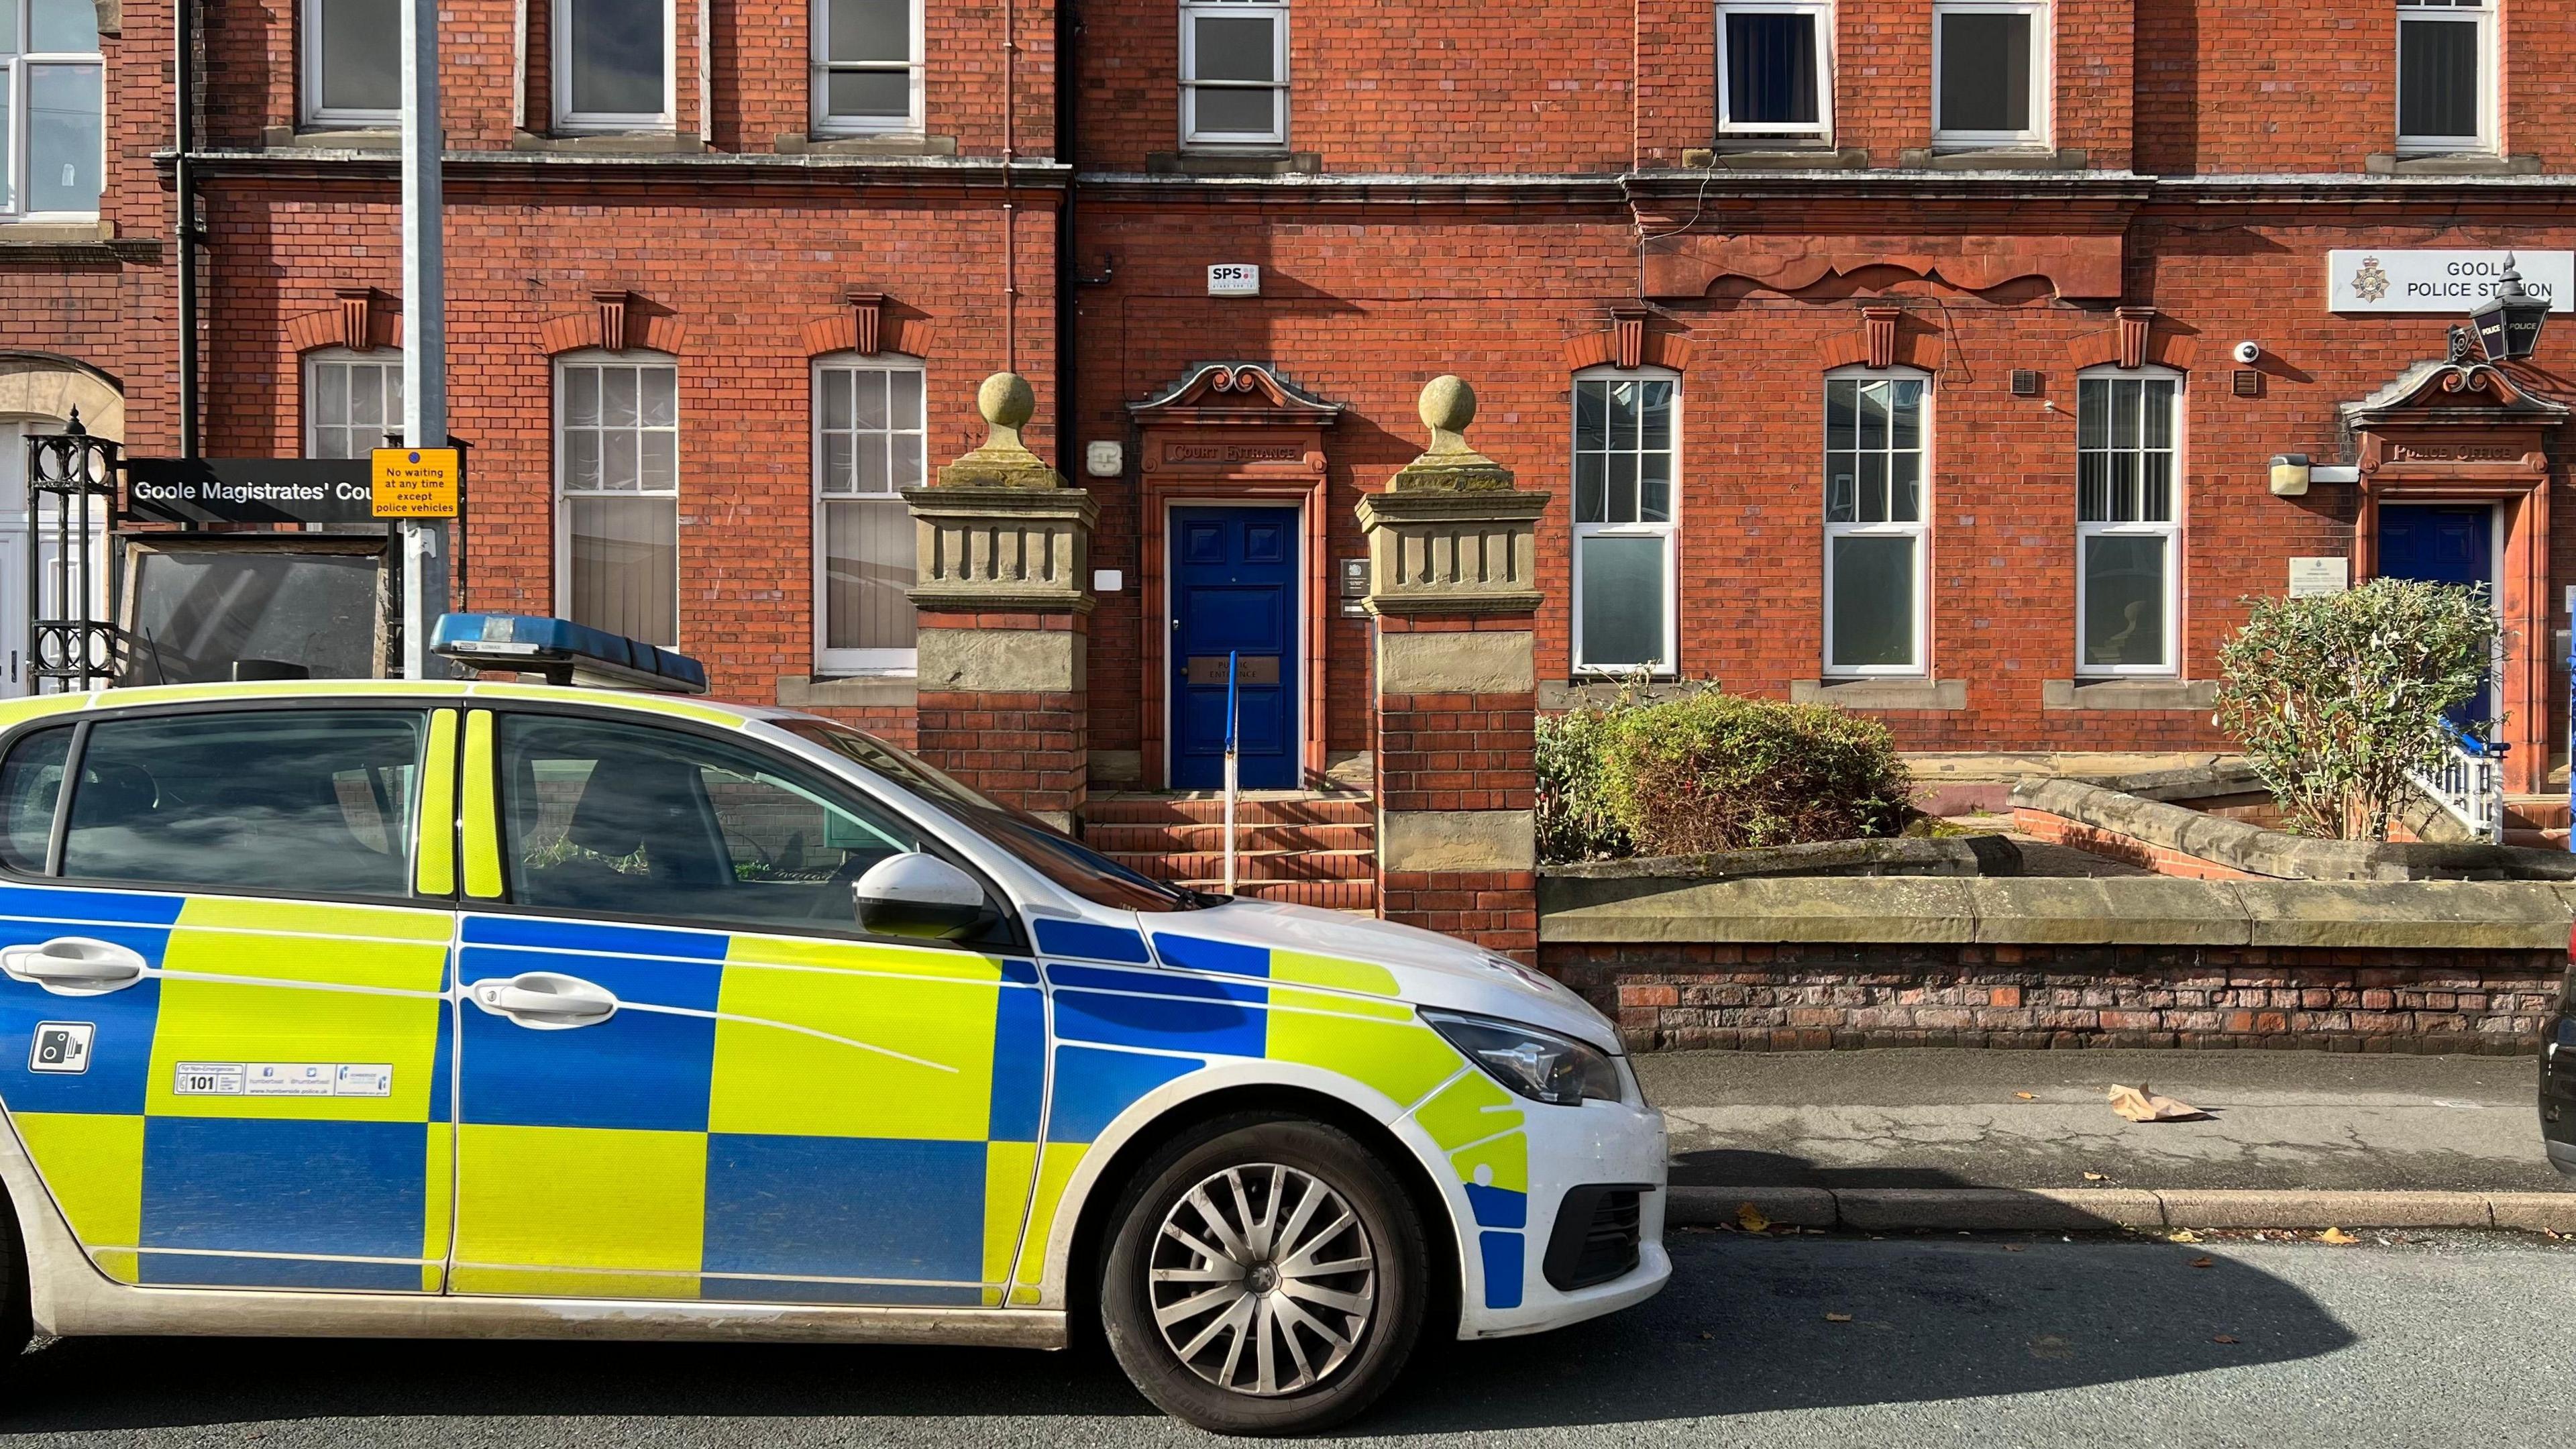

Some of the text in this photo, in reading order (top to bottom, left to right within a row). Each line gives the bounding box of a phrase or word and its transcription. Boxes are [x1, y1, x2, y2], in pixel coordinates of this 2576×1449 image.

[1213, 268, 1242, 280] SPS
[2408, 282, 2553, 297] POLICE STION
[2481, 325, 2501, 336] POLICE
[386, 468, 443, 478] No waiting
[385, 479, 444, 490] at any time
[135, 482, 196, 500] Goole
[202, 482, 329, 503] Magistrates'
[397, 492, 433, 502] except
[376, 502, 453, 513] police vehicles
[1218, 661, 1248, 669] PUIC
[190, 1076, 214, 1090] 101
